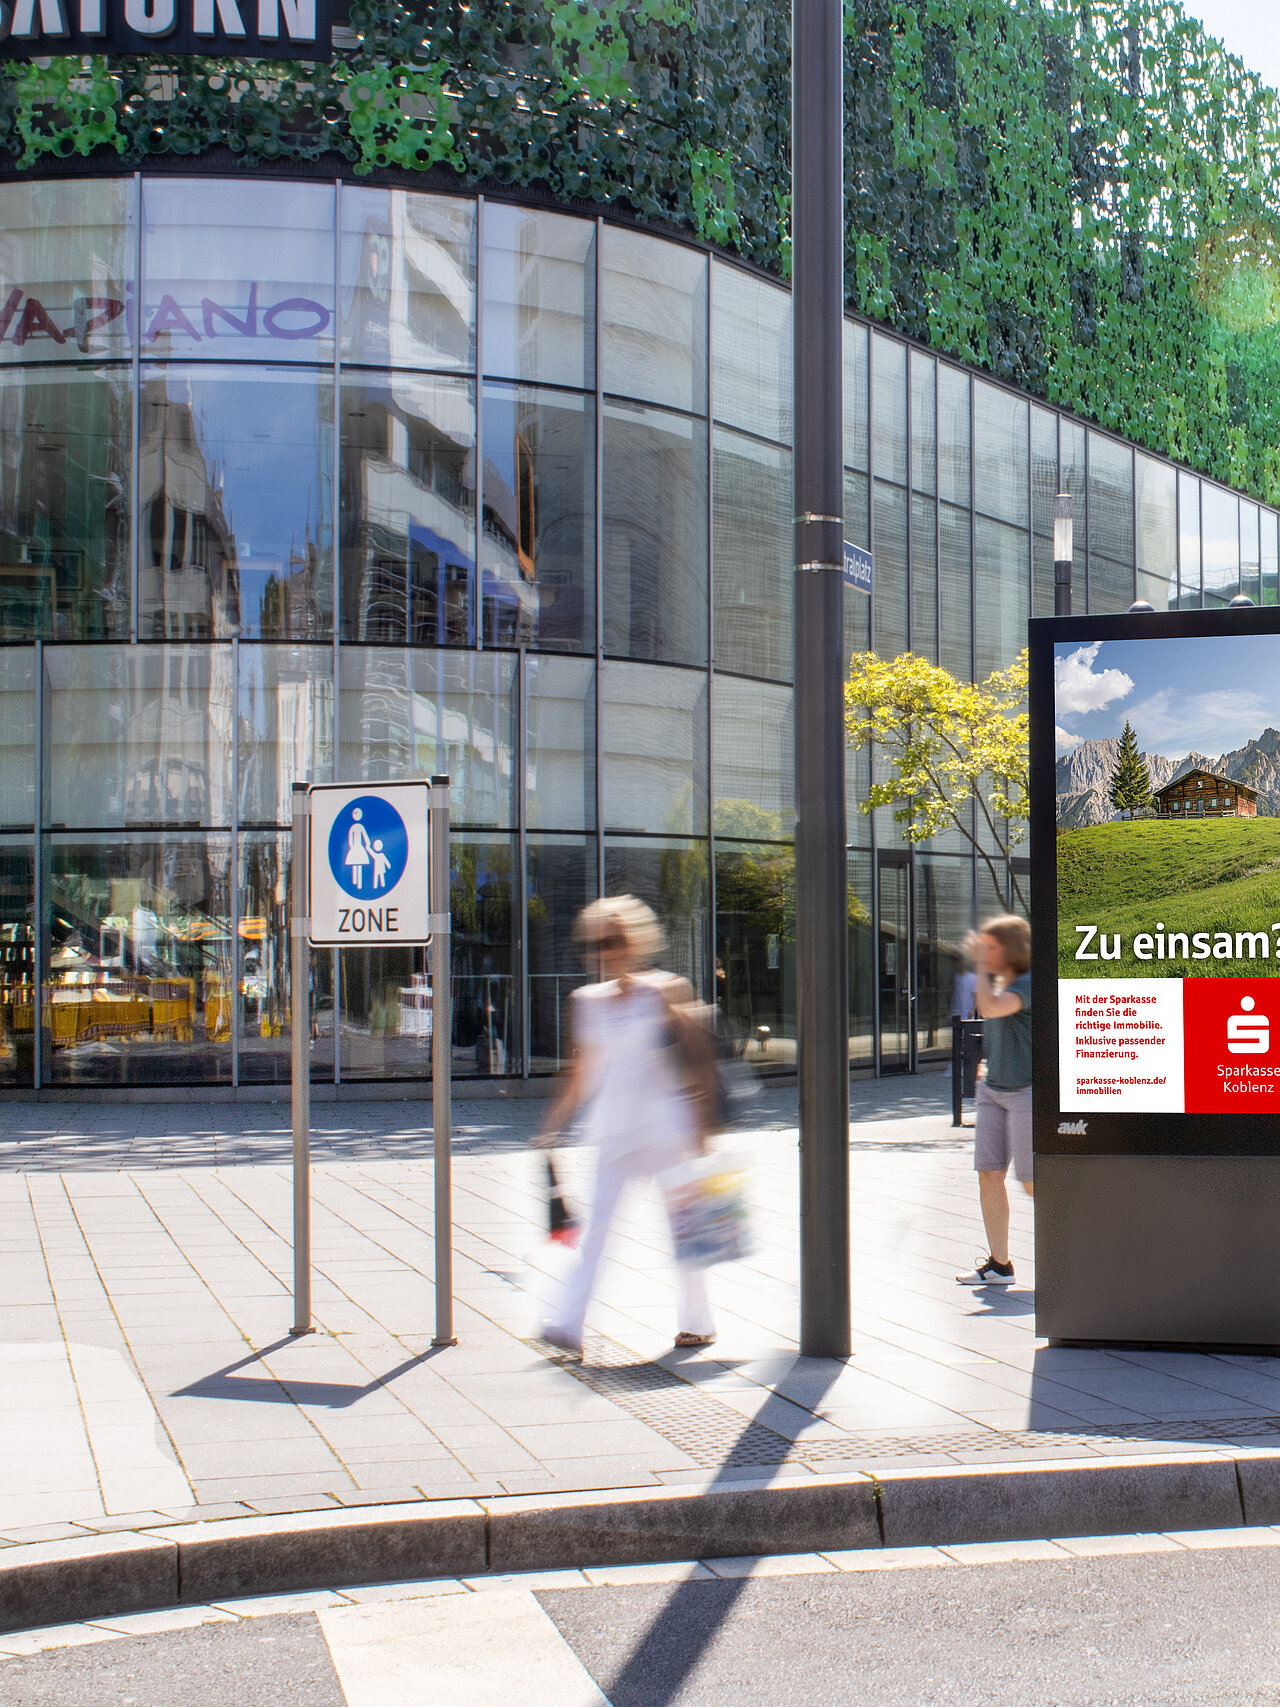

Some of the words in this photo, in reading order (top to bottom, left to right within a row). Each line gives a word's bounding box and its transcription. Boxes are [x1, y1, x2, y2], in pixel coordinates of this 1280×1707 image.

[338, 908, 400, 932] ZONE
[1075, 925, 1121, 960] Zu
[1075, 995, 1090, 1004] Mit
[1092, 995, 1108, 1004] der
[1109, 995, 1157, 1006] Sparkasse
[1075, 1008, 1104, 1017] finden
[1106, 1008, 1121, 1017] Sie
[1122, 1008, 1137, 1017] die
[1075, 1021, 1111, 1032] richtige
[1113, 1021, 1163, 1030] Immobilie.
[1075, 1036, 1117, 1046] Inklusive
[1118, 1036, 1166, 1047] passender
[1076, 1049, 1139, 1061] Finanzierung.
[1217, 1064, 1280, 1079] Sparkasse
[1076, 1076, 1167, 1086] sparkasse-koblenz.de/
[1076, 1087, 1122, 1095] immobilien
[1223, 1081, 1275, 1093] Koblenz
[1057, 1119, 1089, 1135] awk
